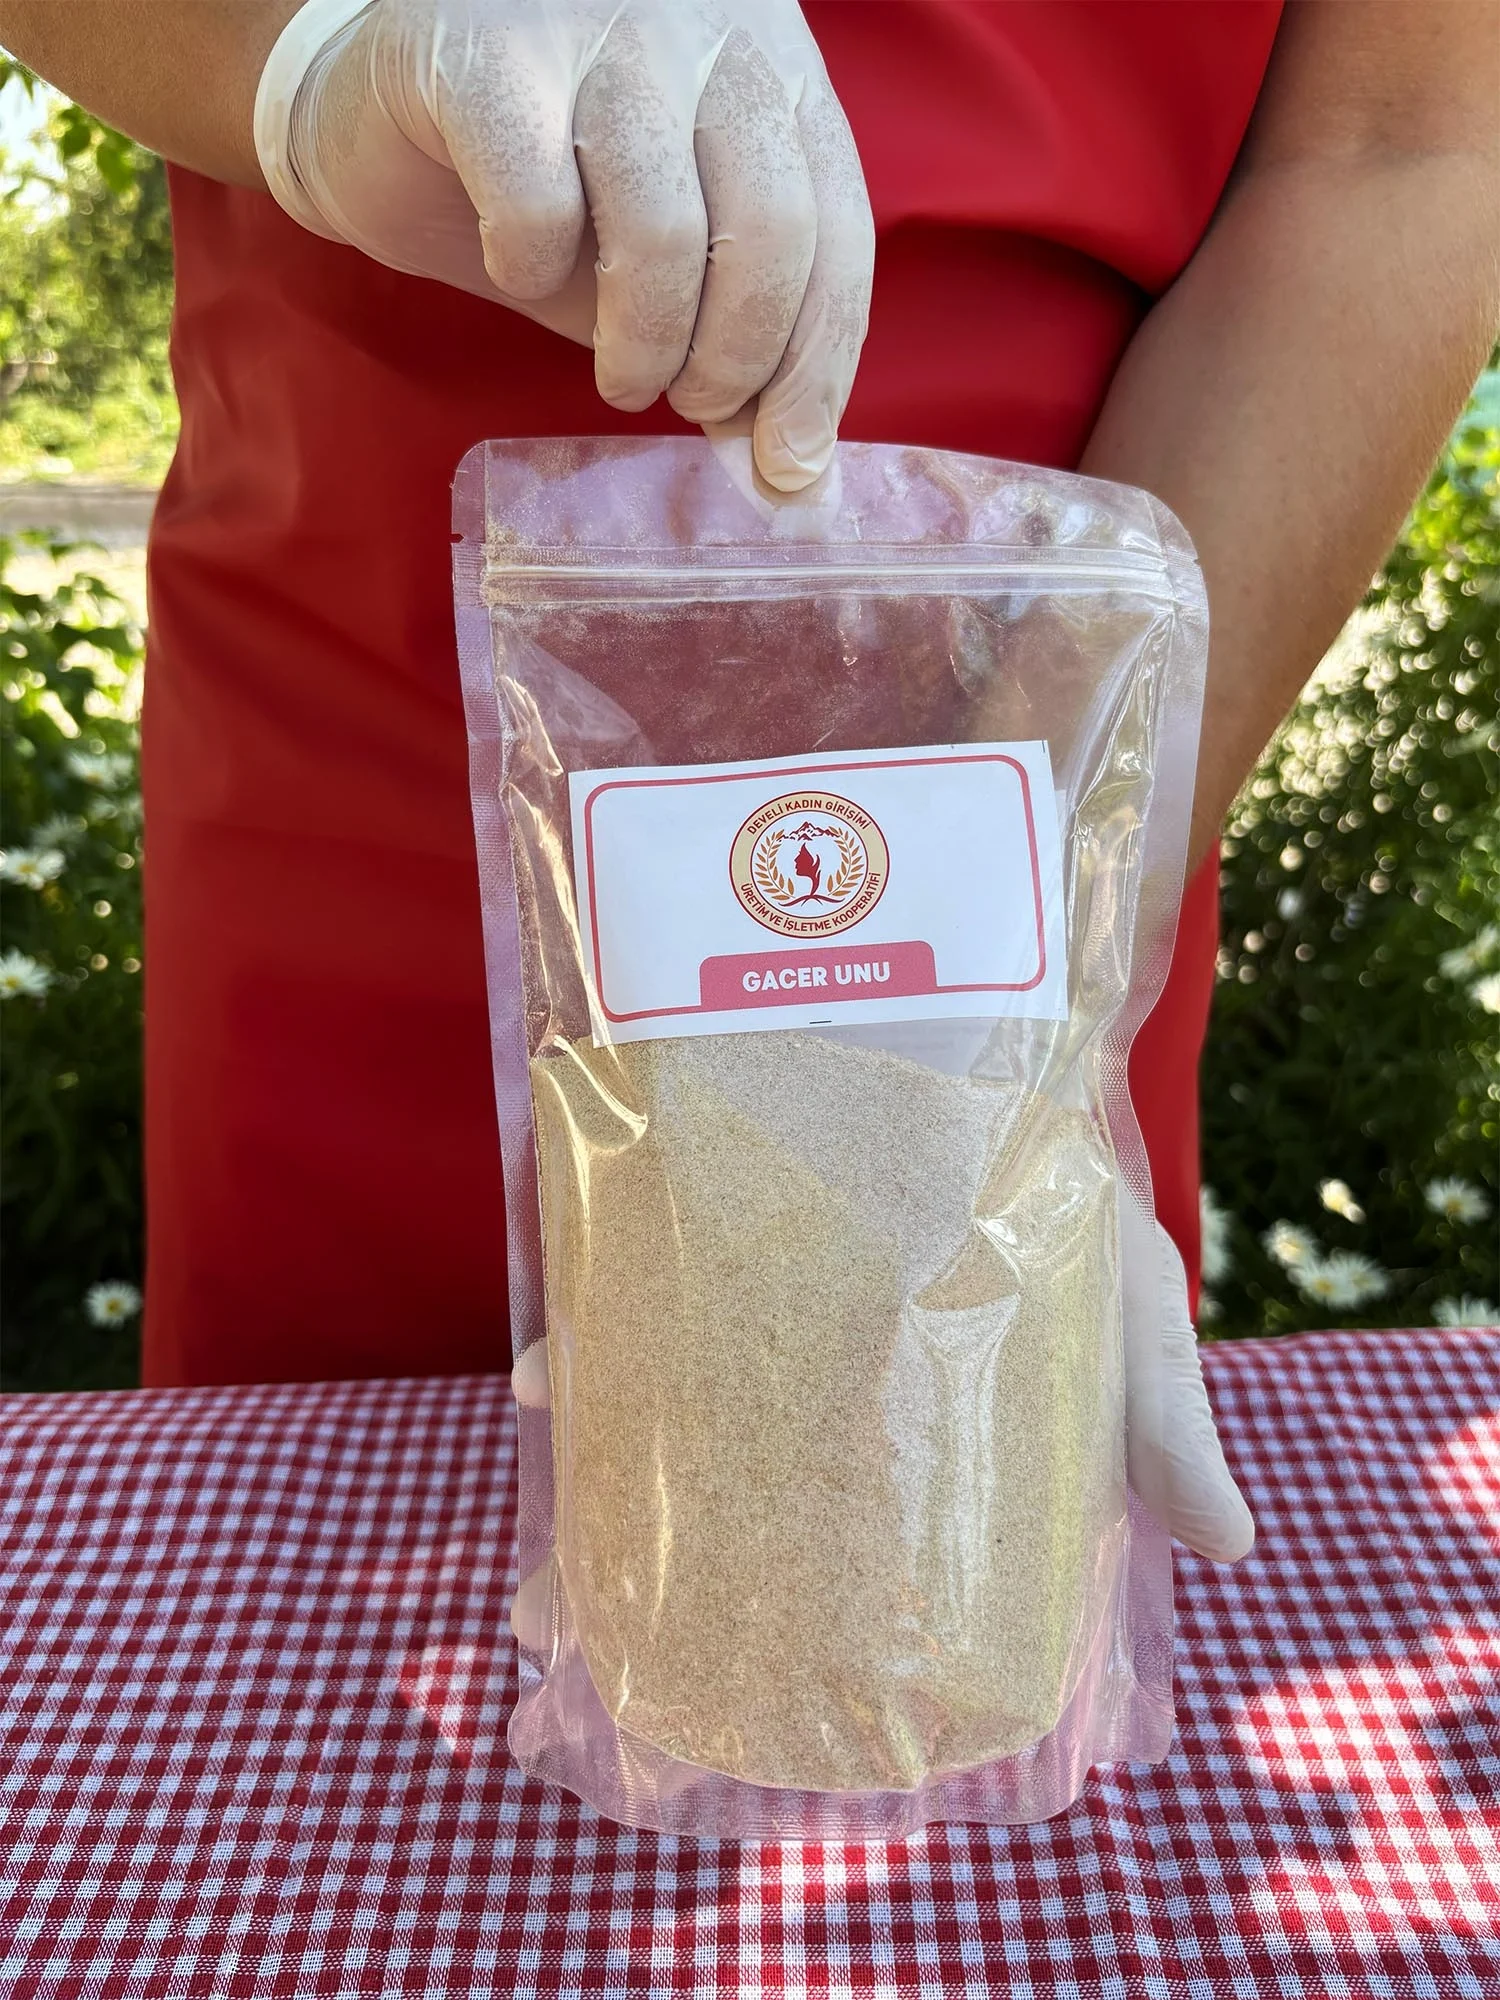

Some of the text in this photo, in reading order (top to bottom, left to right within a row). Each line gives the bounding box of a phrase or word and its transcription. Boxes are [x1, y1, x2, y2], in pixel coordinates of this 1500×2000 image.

[746, 799, 871, 835] DEVELİ KADIN GİRİŞİMİ
[741, 872, 881, 932] ÜRETİM VE İŞLETME KOOPERATİFİ
[742, 961, 891, 993] GACER UNU
